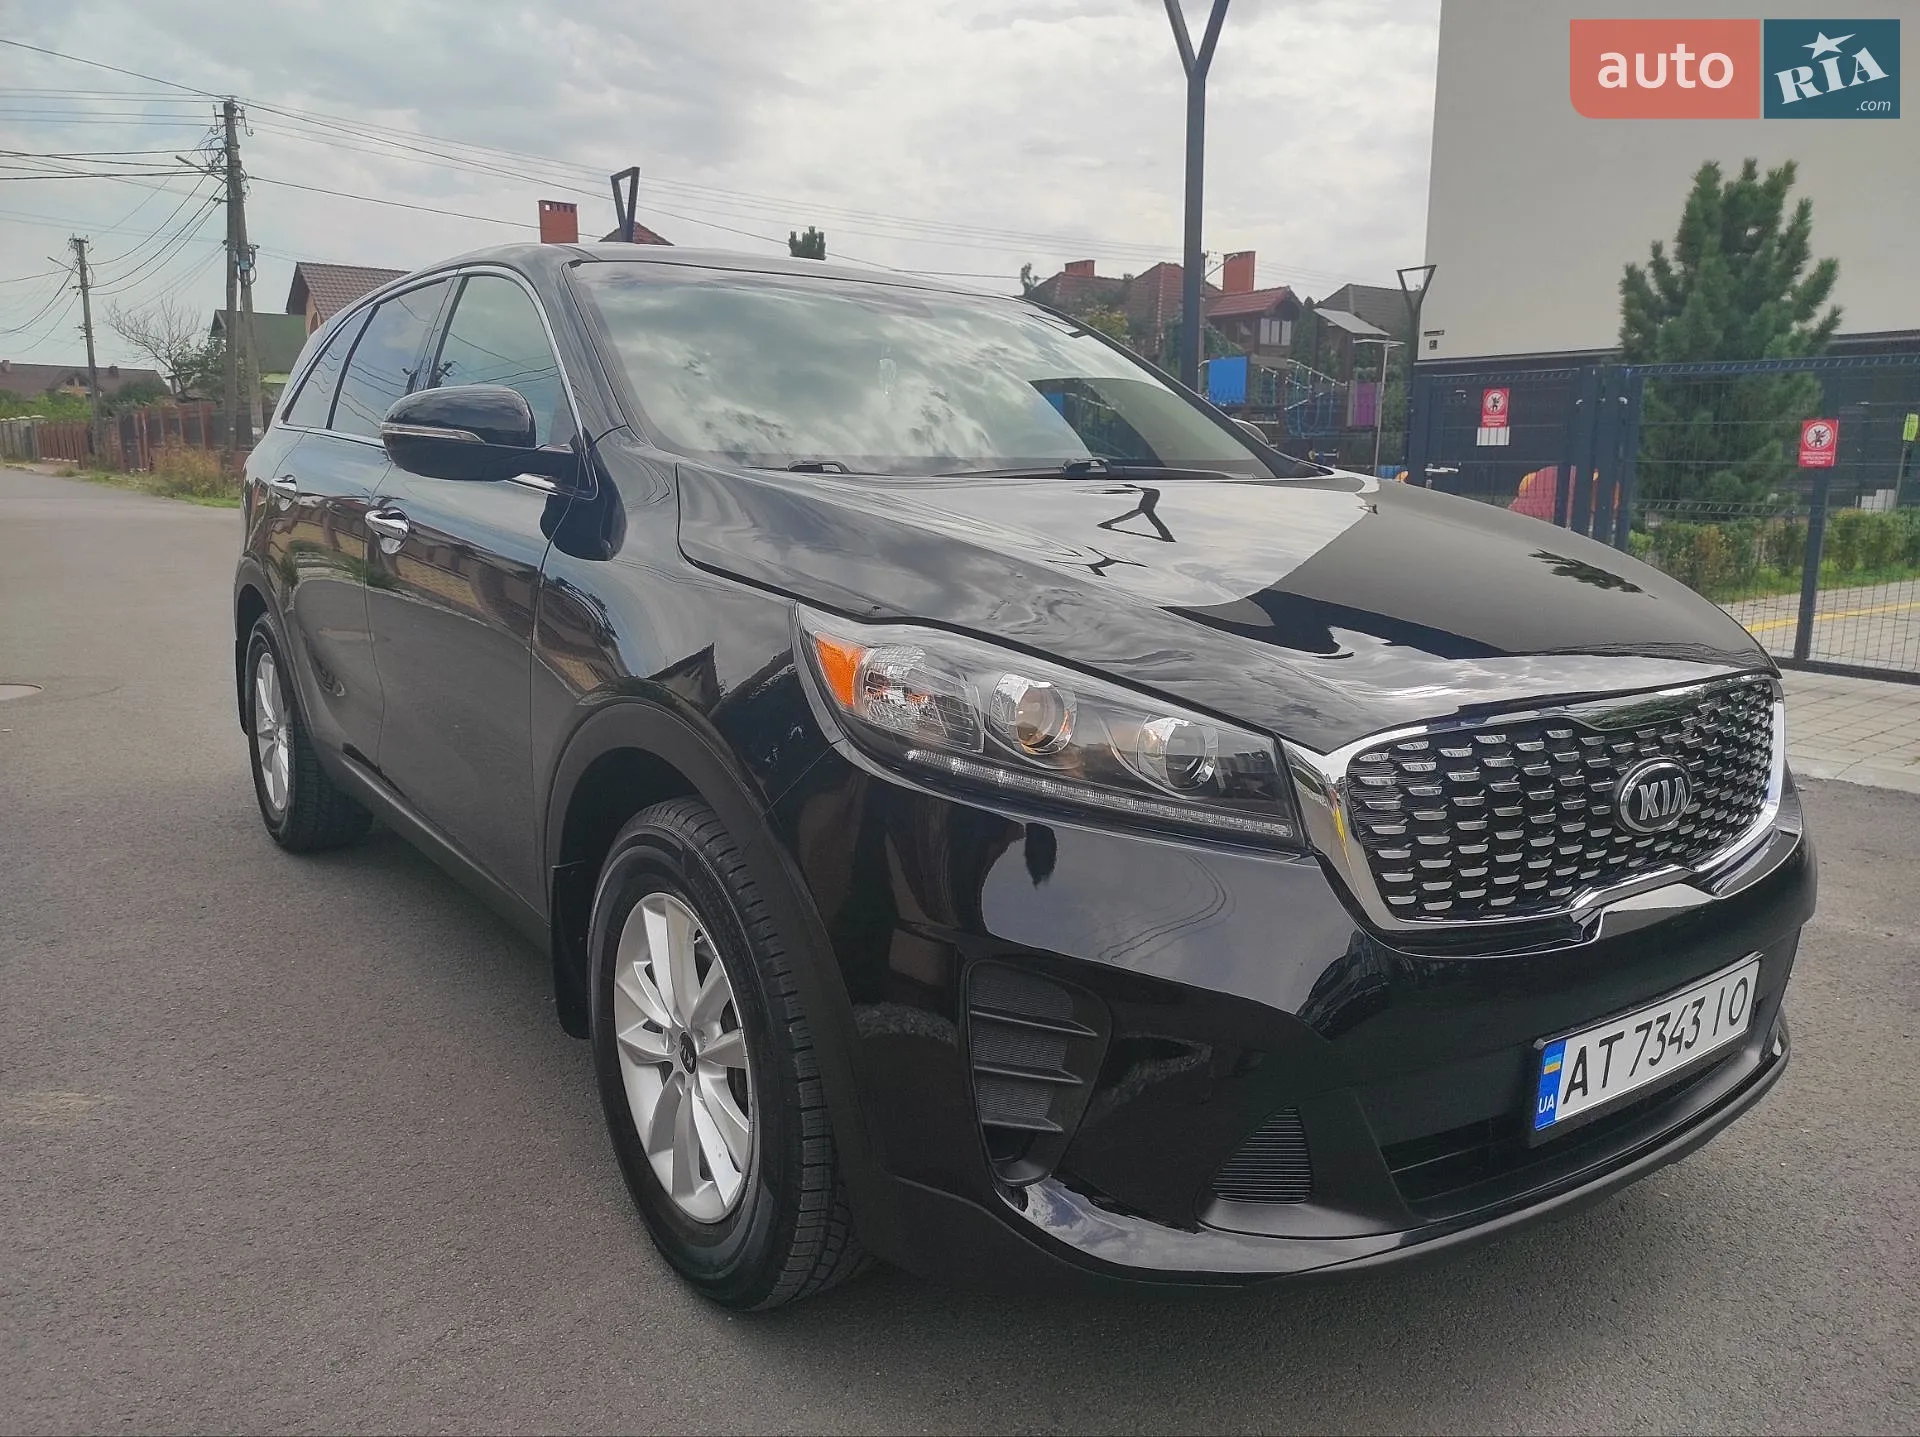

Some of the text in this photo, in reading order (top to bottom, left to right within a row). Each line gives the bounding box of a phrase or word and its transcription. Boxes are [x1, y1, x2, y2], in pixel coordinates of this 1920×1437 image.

[1638, 776, 1687, 821] KIA
[1562, 976, 1749, 1104] AT 7343 IO
[1538, 1094, 1555, 1114] UA
